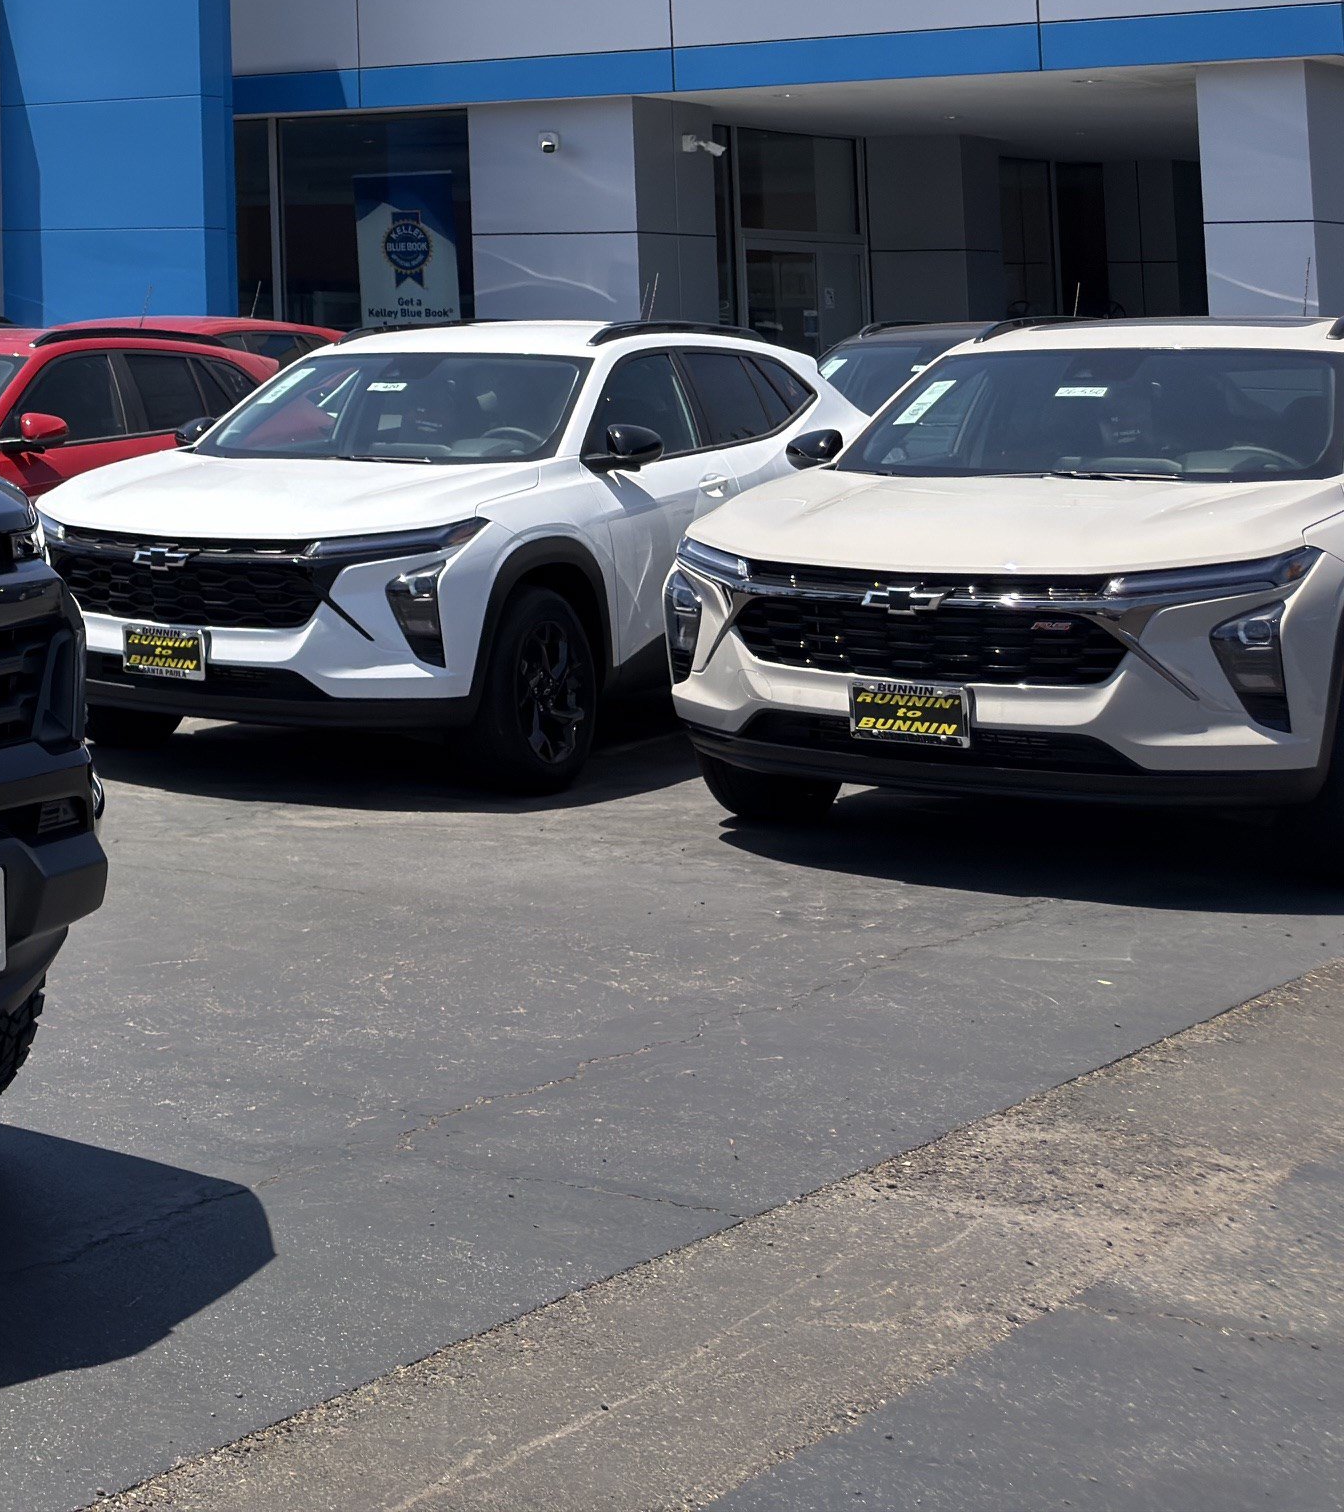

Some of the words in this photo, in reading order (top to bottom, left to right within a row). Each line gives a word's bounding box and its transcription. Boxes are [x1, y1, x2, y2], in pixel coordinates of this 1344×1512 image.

[390, 225, 424, 240] KELLEY
[397, 297, 414, 307] Get
[416, 298, 422, 307] a
[368, 308, 398, 319] Kelley
[400, 308, 422, 318] Blue
[142, 627, 180, 638] BUNNIN
[128, 634, 199, 648] RUNNIN'
[154, 647, 172, 655] to
[129, 655, 197, 670] BUNNIN
[878, 683, 934, 696] BUNNIN
[856, 692, 960, 708] RUNNIN'
[896, 708, 922, 717] to
[858, 717, 957, 735] BUNNIN
